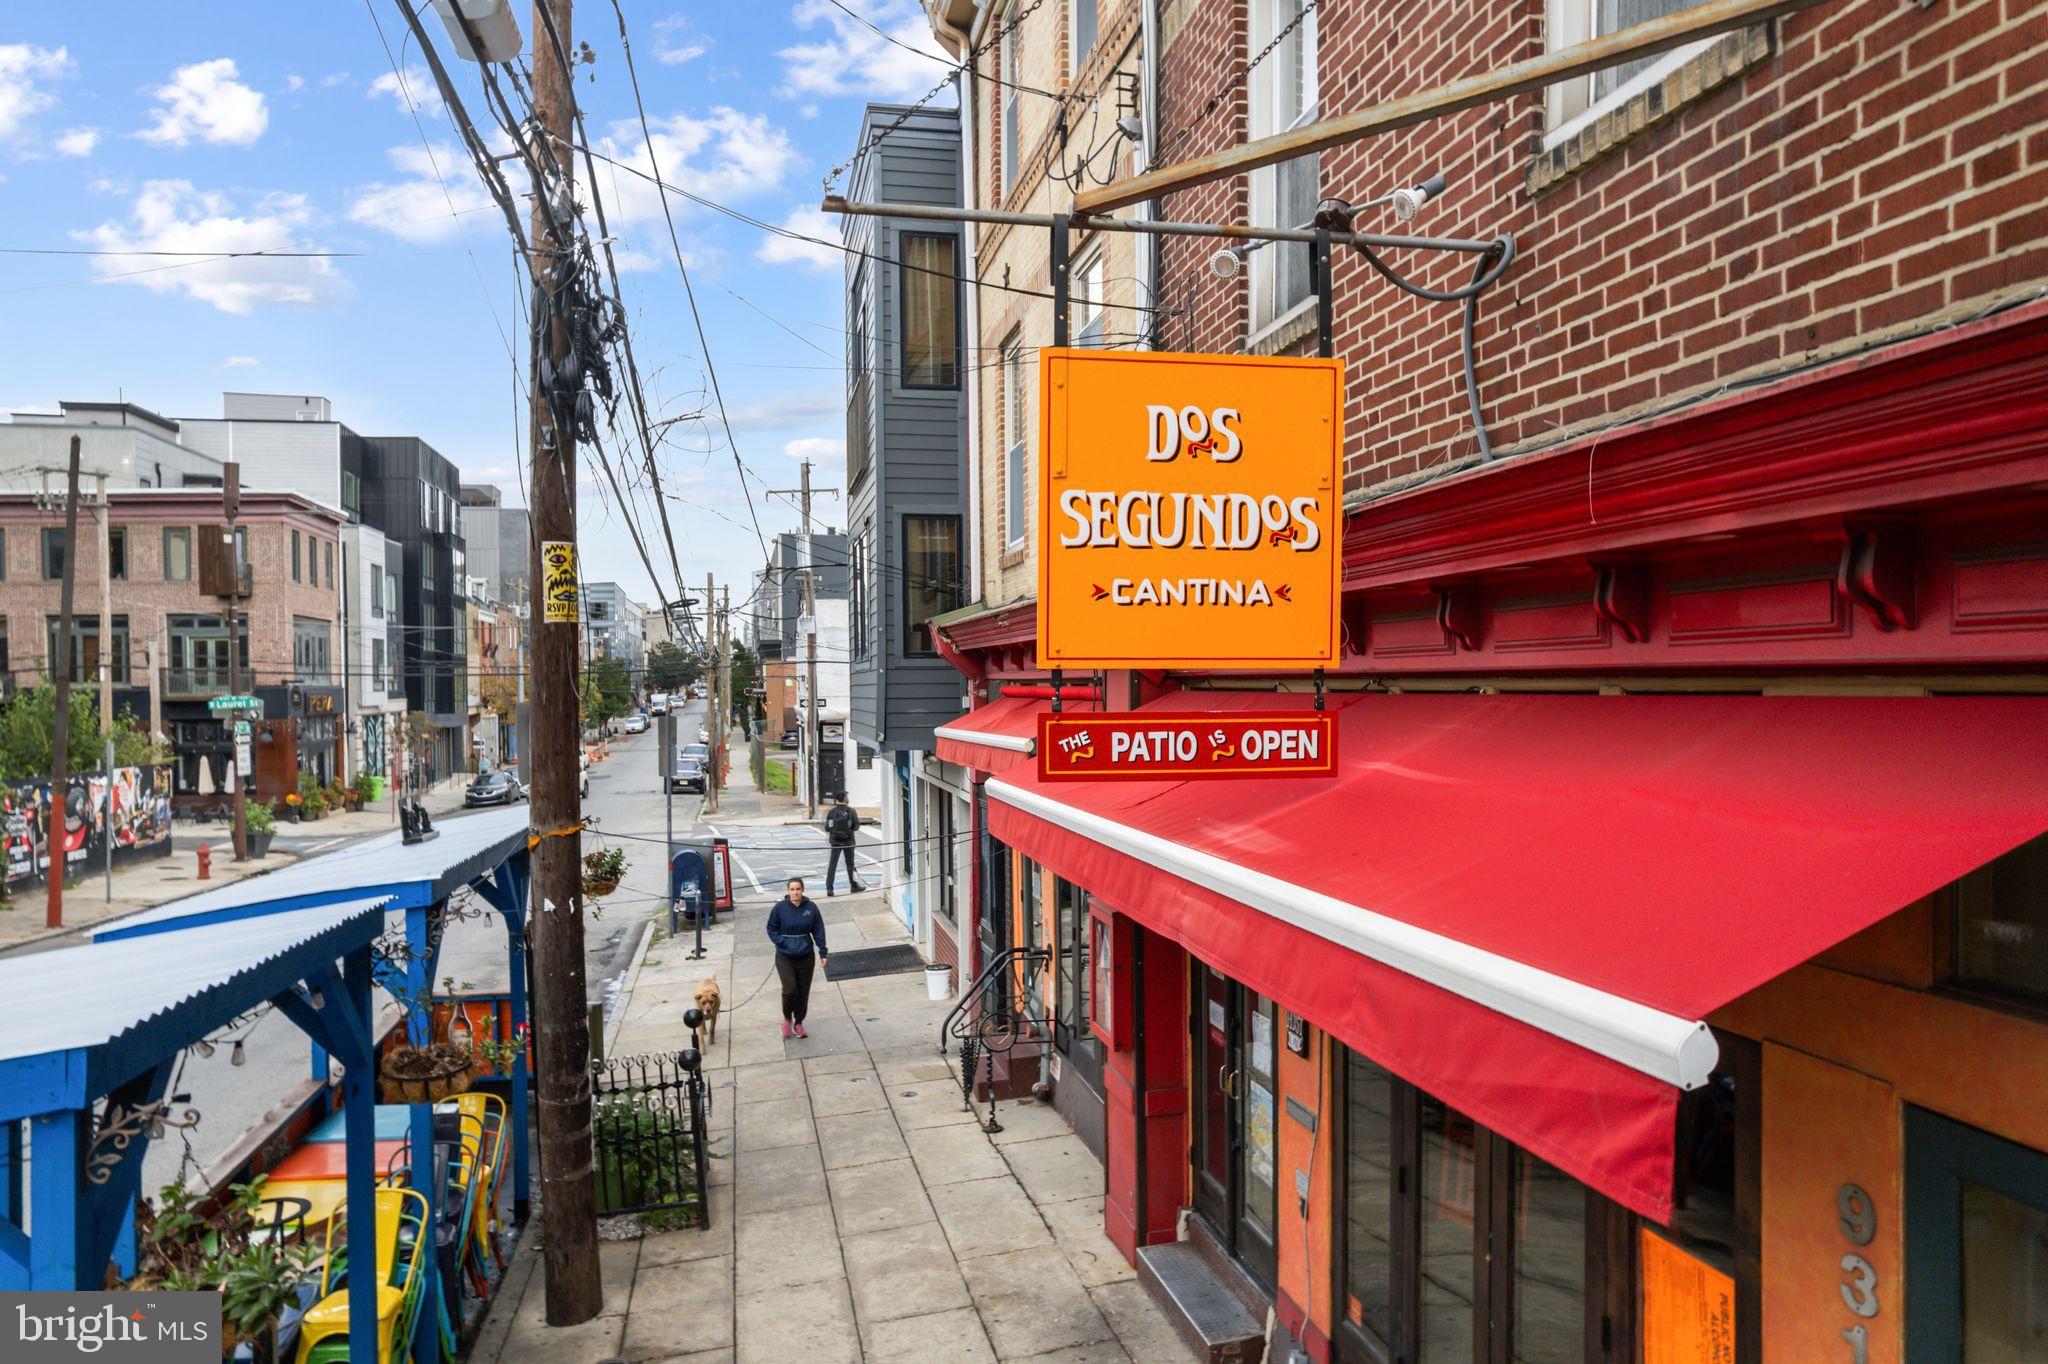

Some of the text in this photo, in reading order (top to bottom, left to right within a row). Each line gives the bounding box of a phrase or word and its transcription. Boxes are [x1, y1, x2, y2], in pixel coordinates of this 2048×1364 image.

[1145, 404, 1243, 463] DOS
[1060, 489, 1321, 552] SEGUNDOS
[1112, 577, 1273, 606] CANTINA
[216, 700, 246, 709] Laurel
[1058, 729, 1319, 762] THE PATIO IS OPEN
